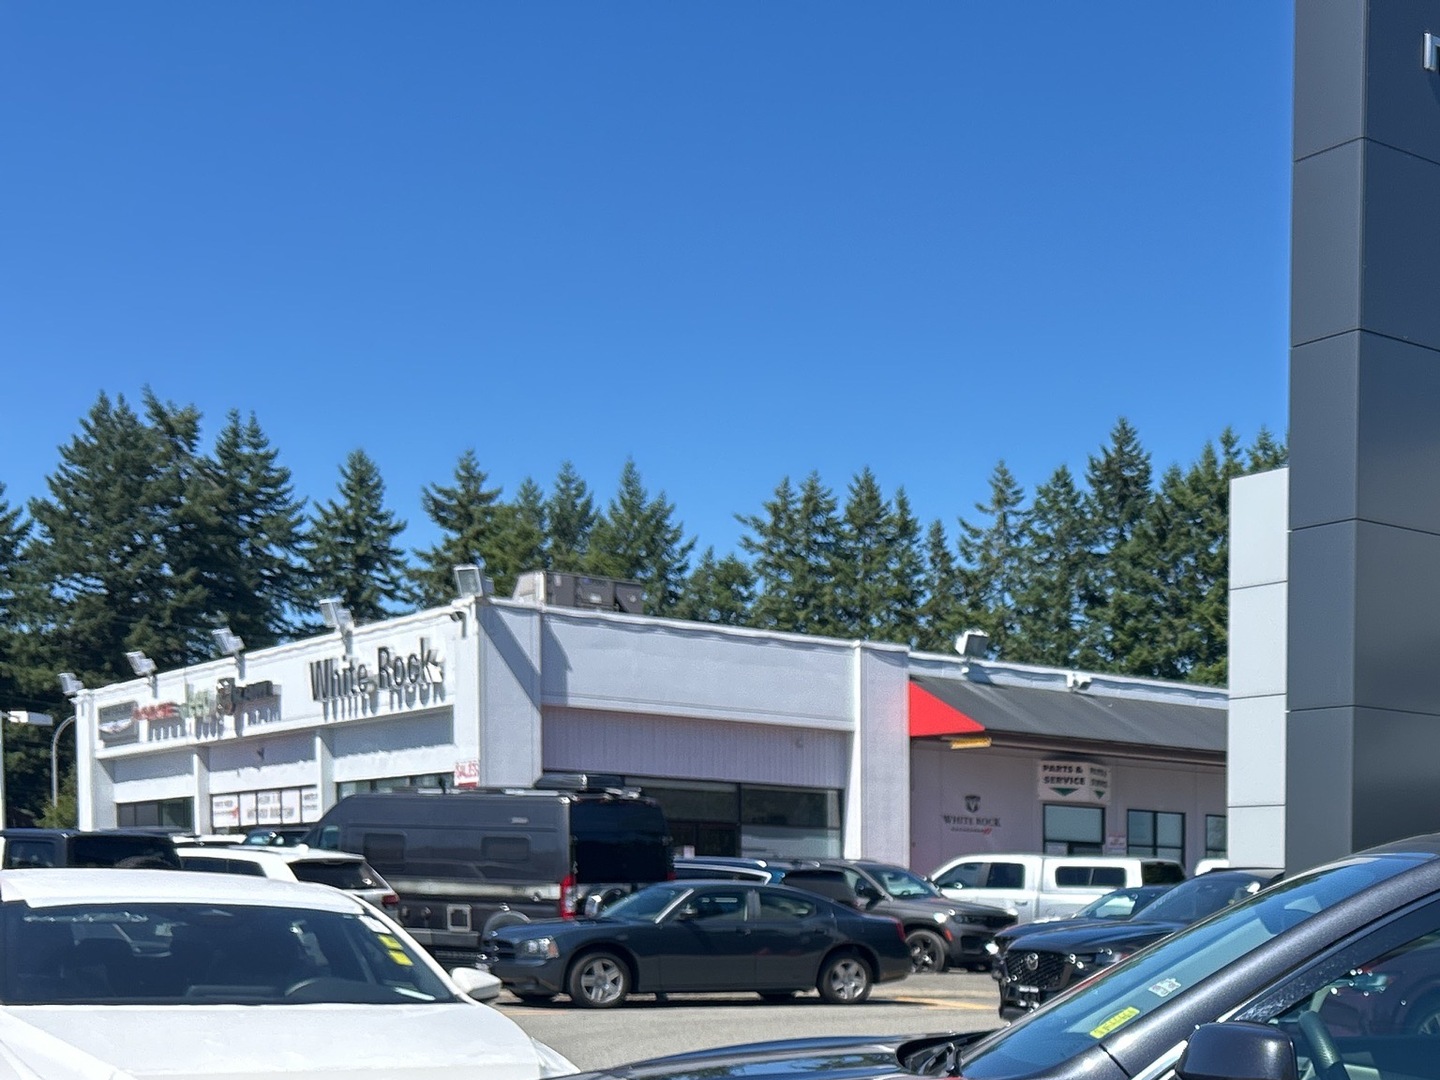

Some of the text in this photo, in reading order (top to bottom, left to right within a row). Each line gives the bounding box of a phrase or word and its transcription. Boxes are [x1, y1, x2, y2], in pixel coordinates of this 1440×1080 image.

[310, 637, 442, 701] White Rock
[1043, 765, 1083, 774] PARTS &
[1043, 776, 1085, 786] SERVICE
[943, 815, 1001, 827] WHITE ROCK
